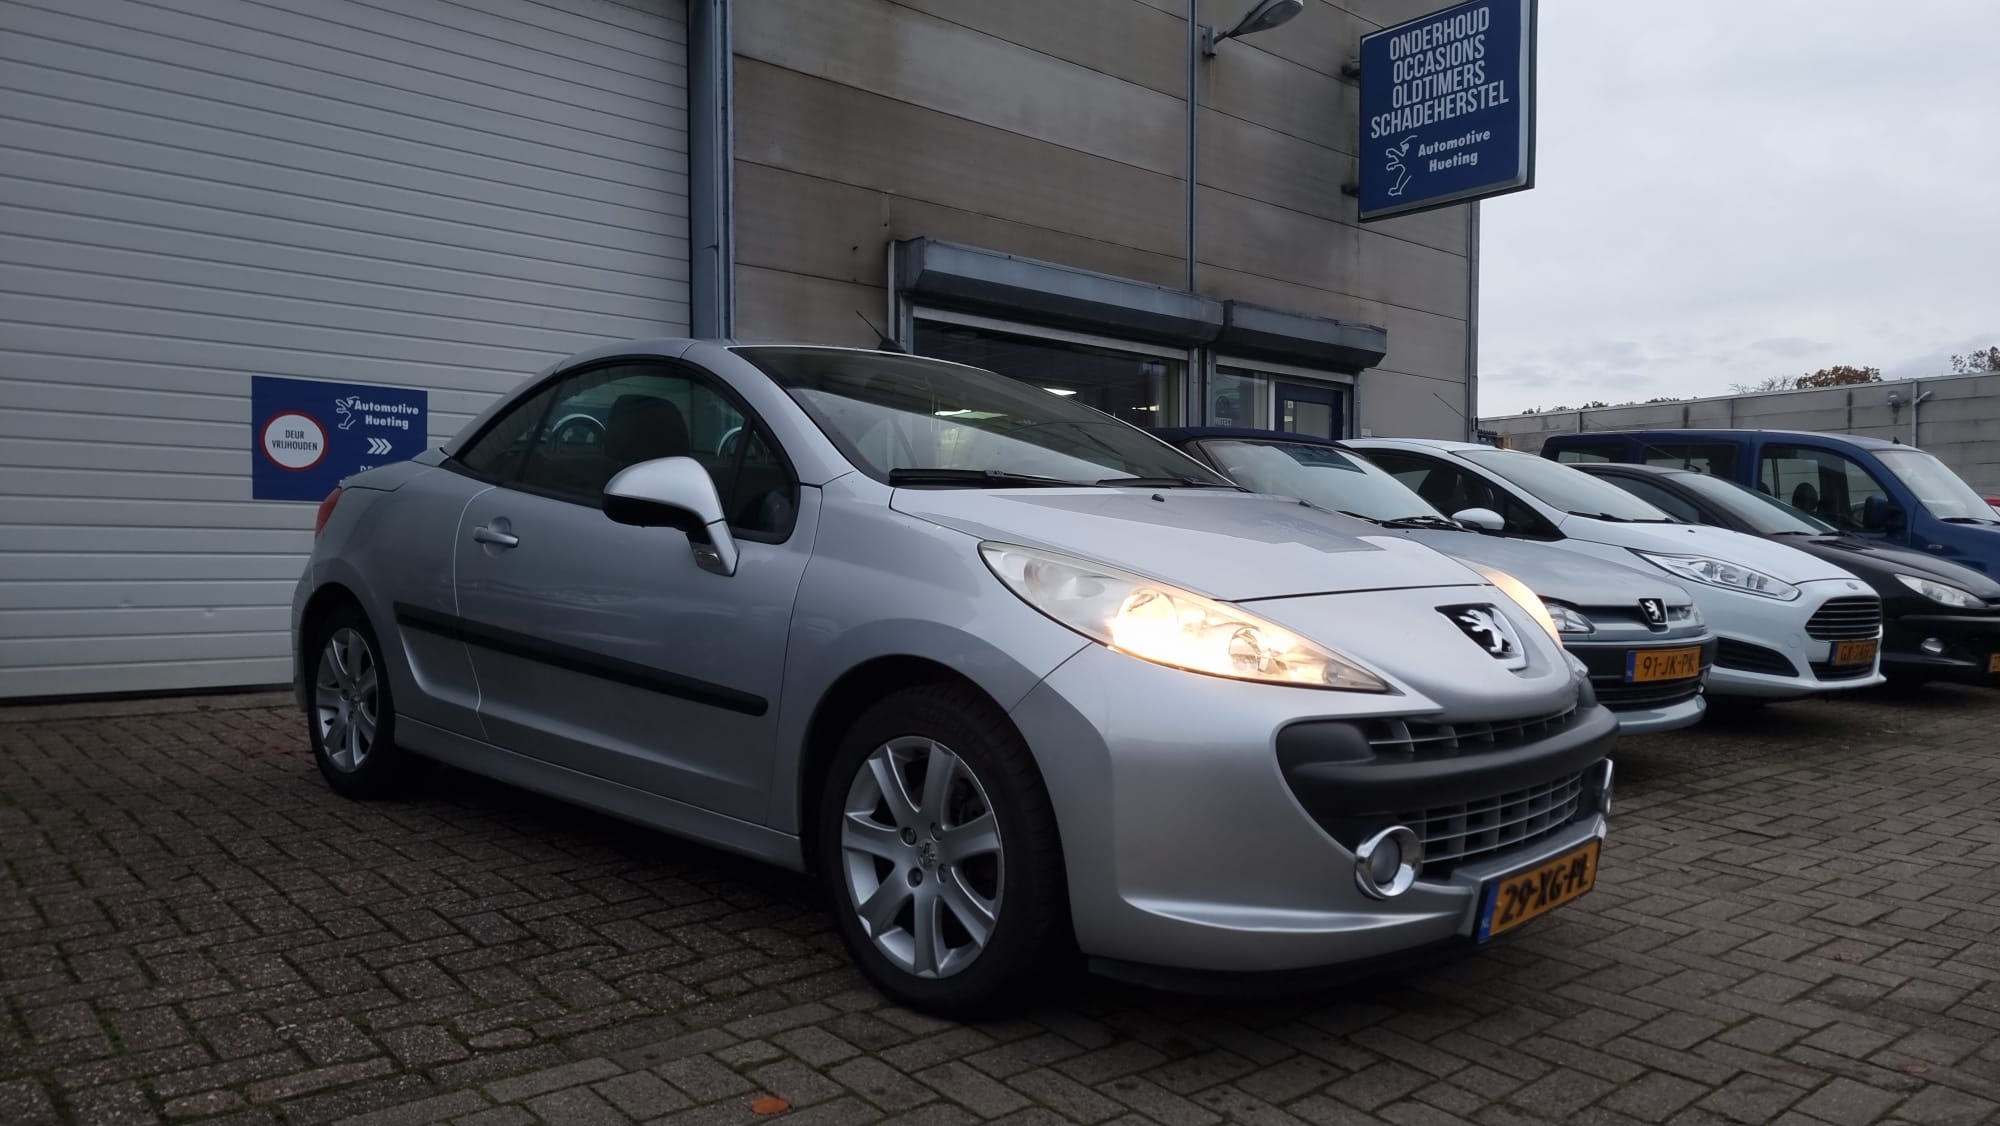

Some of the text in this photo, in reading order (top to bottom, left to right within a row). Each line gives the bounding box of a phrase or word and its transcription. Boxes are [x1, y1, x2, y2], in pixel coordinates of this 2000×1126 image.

[1390, 7, 1490, 61] ONDERHOUD
[1393, 34, 1486, 84] OCCASIONS
[1392, 60, 1485, 109] OLDTIMERS
[1371, 80, 1509, 139] SCHADEHERSTEL
[1418, 130, 1491, 157] Automotive
[1429, 152, 1478, 173] Hueting
[354, 400, 419, 415] Automotive
[285, 429, 305, 439] DEUR
[365, 415, 409, 430] Hueting
[271, 440, 318, 451] VRIJHOUDEN
[1643, 653, 1697, 678] 91-JK-PK
[1499, 853, 1589, 926] 29-XG-PL
